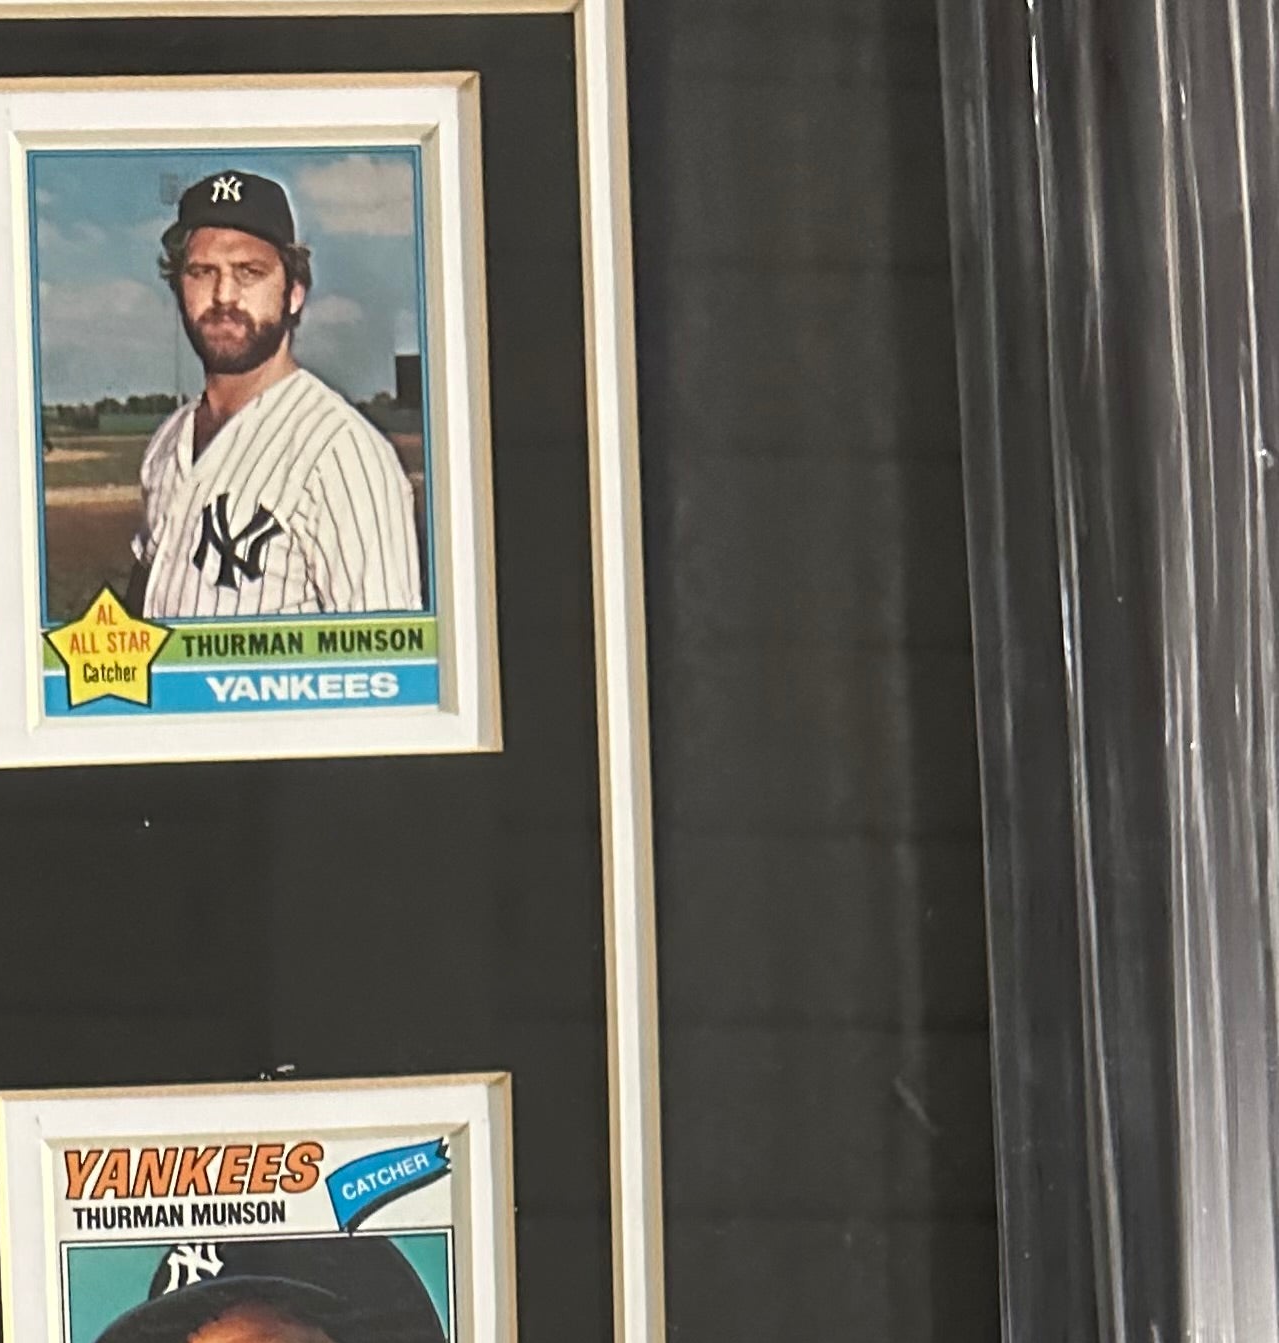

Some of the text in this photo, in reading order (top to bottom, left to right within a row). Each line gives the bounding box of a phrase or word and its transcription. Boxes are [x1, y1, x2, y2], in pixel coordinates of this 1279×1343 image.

[192, 494, 284, 588] NY
[96, 604, 118, 626] AL
[69, 630, 151, 654] ALL STAR
[182, 627, 424, 659] THURMAN MUNSON
[83, 662, 138, 684] Catcher
[206, 673, 400, 702] YANKEES
[64, 1141, 324, 1200] YANKEES
[340, 1152, 431, 1203] CATCHER
[73, 1200, 286, 1231] THURMAN MUNSON
